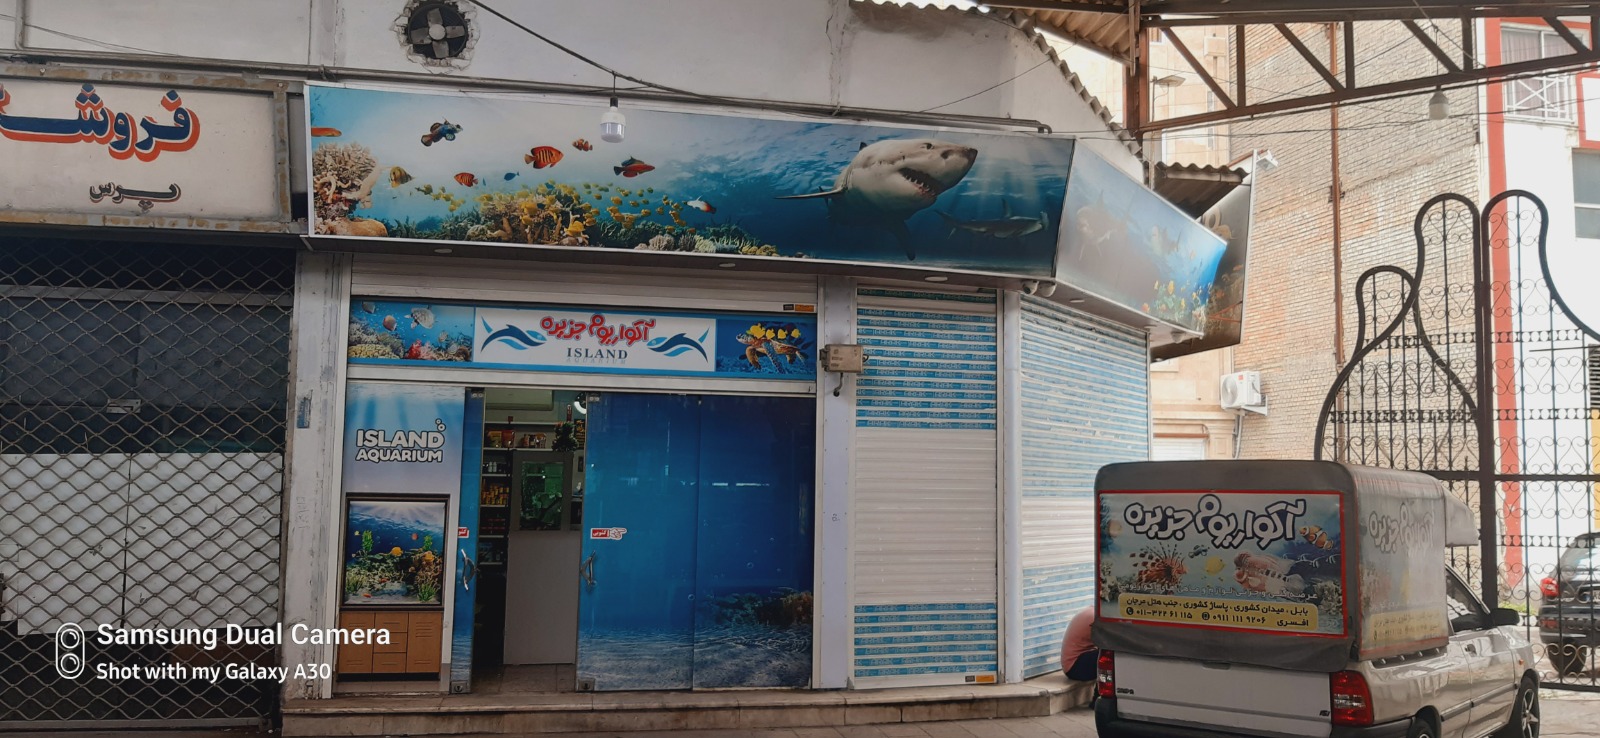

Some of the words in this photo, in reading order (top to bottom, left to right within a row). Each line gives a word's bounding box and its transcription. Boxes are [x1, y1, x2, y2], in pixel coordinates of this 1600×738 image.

[0, 83, 200, 162] فروش
[89, 182, 181, 211] پرس
[540, 315, 587, 340] جزیره
[567, 347, 628, 359] ISLAND
[356, 429, 446, 449] ISLAND
[355, 448, 443, 463] AQUARIUM
[1124, 502, 1194, 541] جزیره
[1277, 619, 1309, 627] افسری
